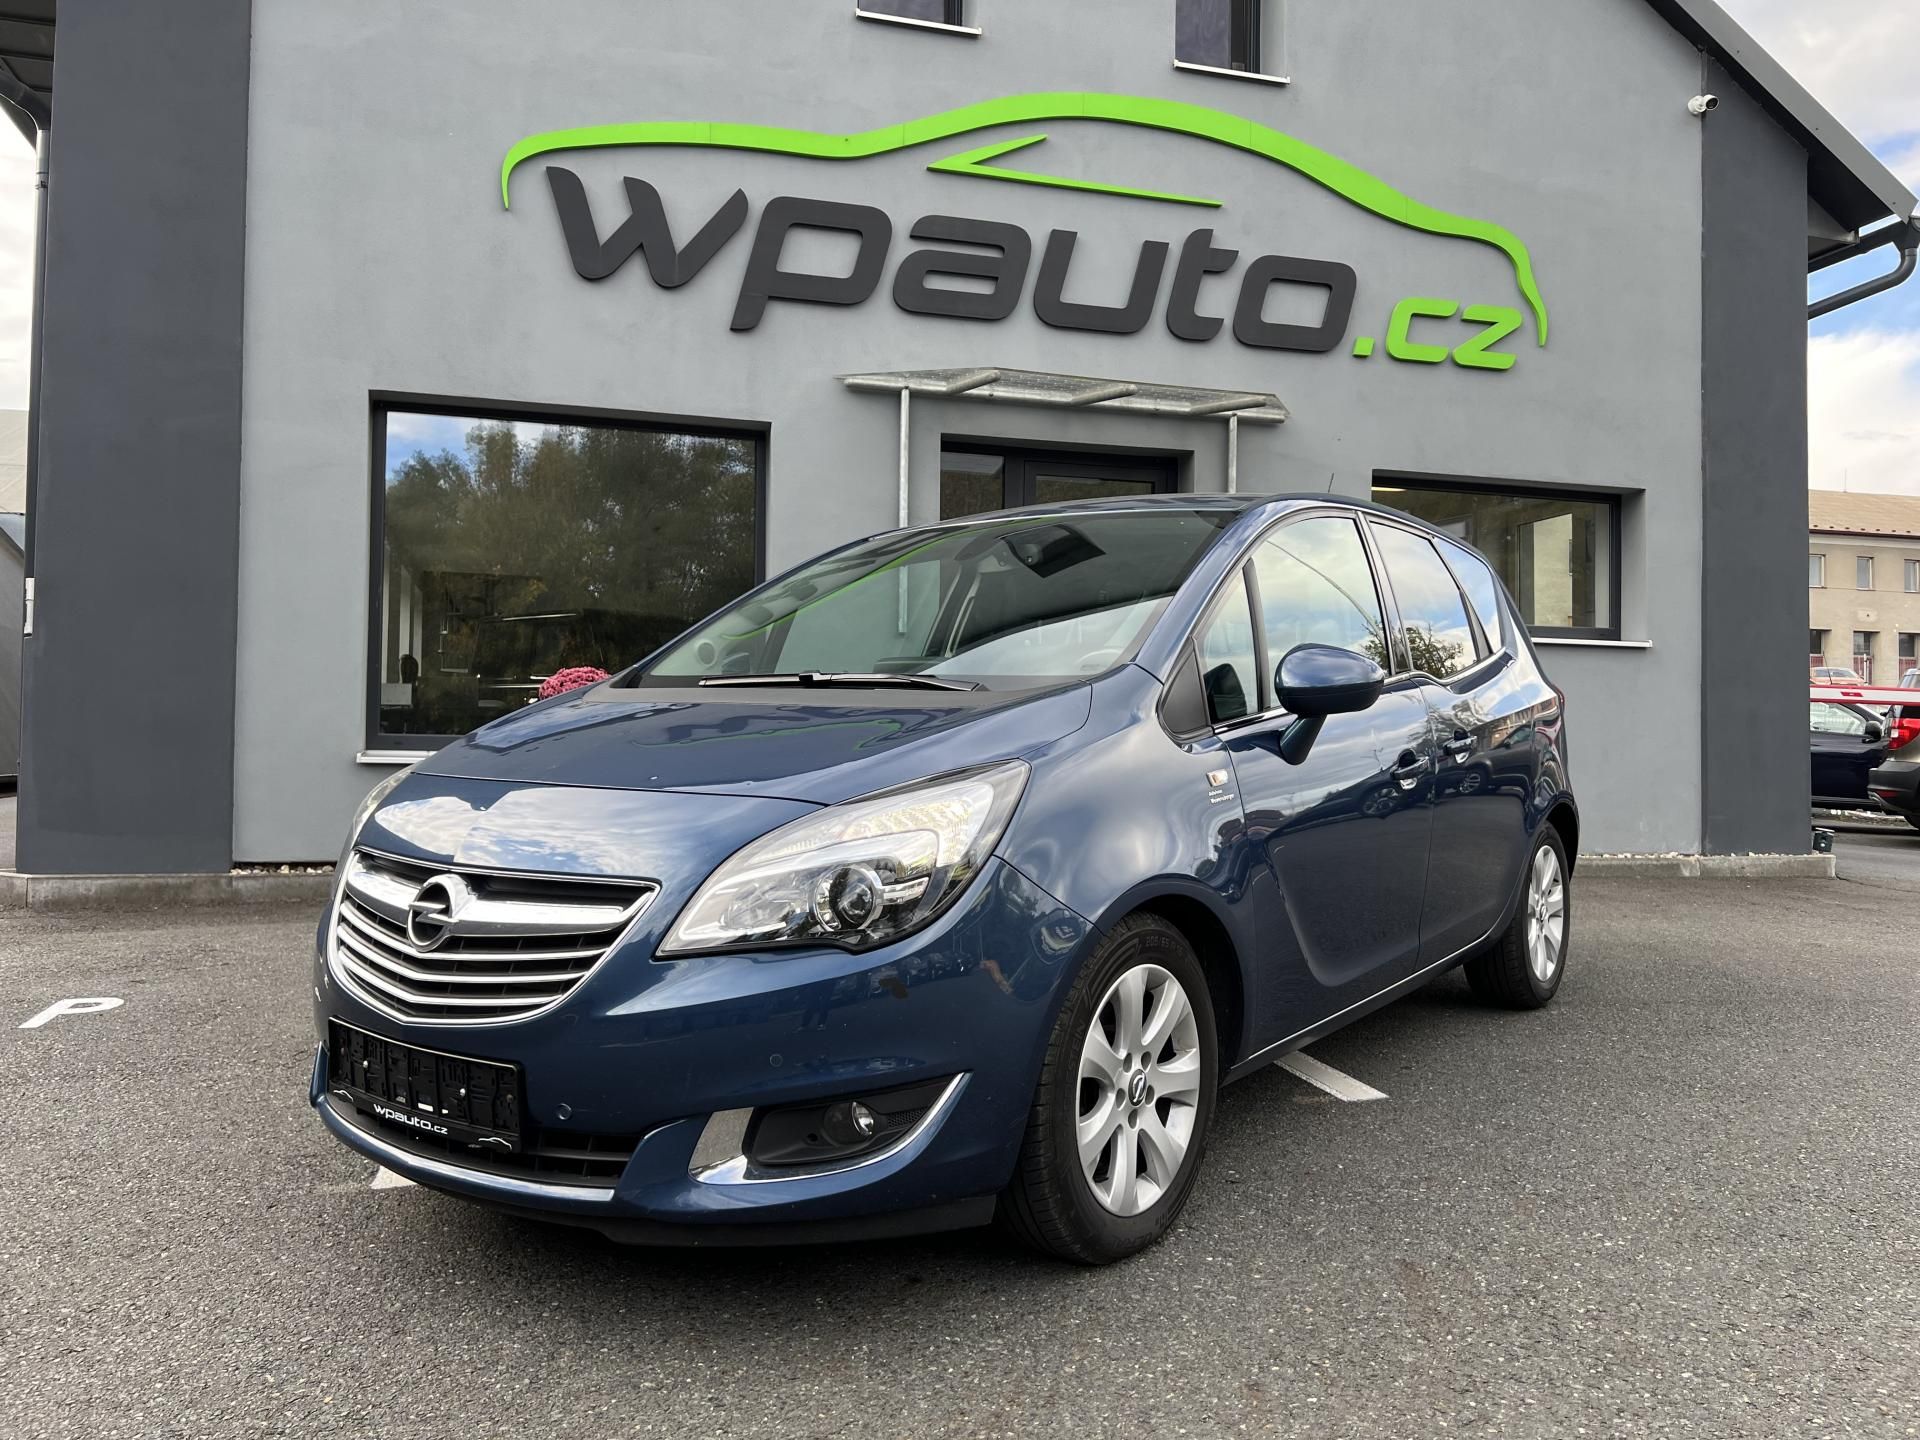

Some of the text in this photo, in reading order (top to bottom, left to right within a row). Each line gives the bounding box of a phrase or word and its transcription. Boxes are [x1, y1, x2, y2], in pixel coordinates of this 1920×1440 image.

[546, 165, 1524, 370] wpauto.cz
[17, 996, 125, 1029] P
[373, 1103, 448, 1135] wpauto.cz
